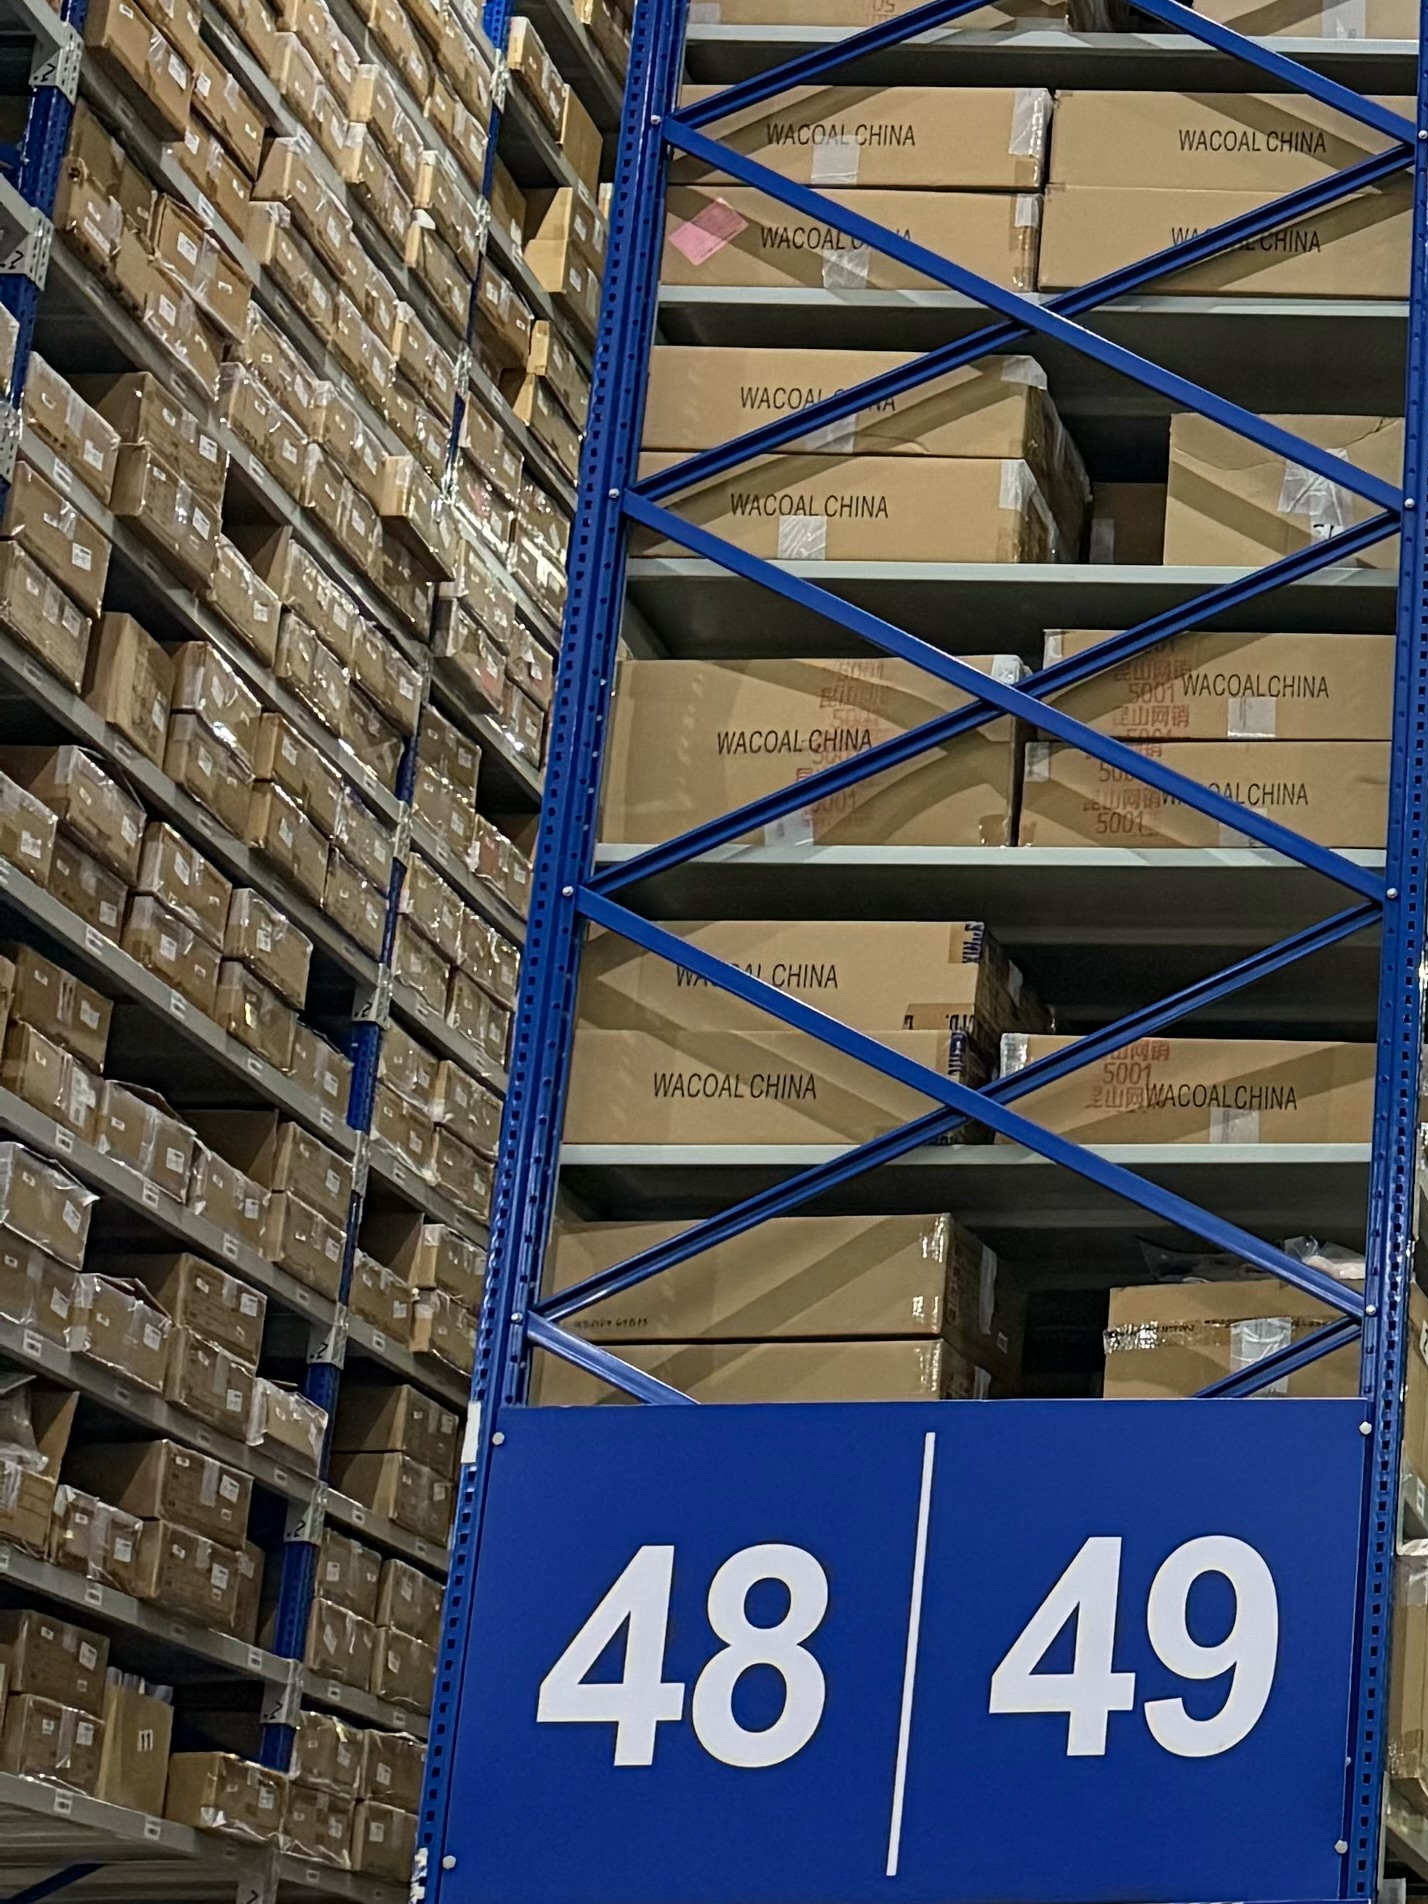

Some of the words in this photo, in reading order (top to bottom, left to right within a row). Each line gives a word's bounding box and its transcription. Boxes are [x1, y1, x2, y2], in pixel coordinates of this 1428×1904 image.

[766, 123, 850, 146] WACOAL
[854, 124, 916, 147] CHINA
[1178, 128, 1262, 151] WACOAL
[1265, 129, 1326, 153] CHINA
[760, 226, 848, 249] WACOAL
[1259, 229, 1321, 252] CHINA
[730, 493, 824, 519] WACOAL
[827, 494, 889, 520] CHINA
[1181, 673, 1266, 697] WACOAL
[1267, 674, 1329, 698] CHINA
[716, 730, 804, 756] WACOAL
[808, 728, 872, 753] CHINA
[1247, 783, 1308, 806] CHINA
[1096, 811, 1144, 834] 5001
[771, 963, 837, 989] CHINA
[653, 1073, 746, 1099] WACOAL
[750, 1073, 816, 1099] CHINA
[1102, 1062, 1150, 1085] 5001
[1147, 1084, 1232, 1108] WACOAL
[1235, 1085, 1297, 1109] CHINA
[537, 1543, 829, 1768] 48
[989, 1535, 1279, 1759] 49
